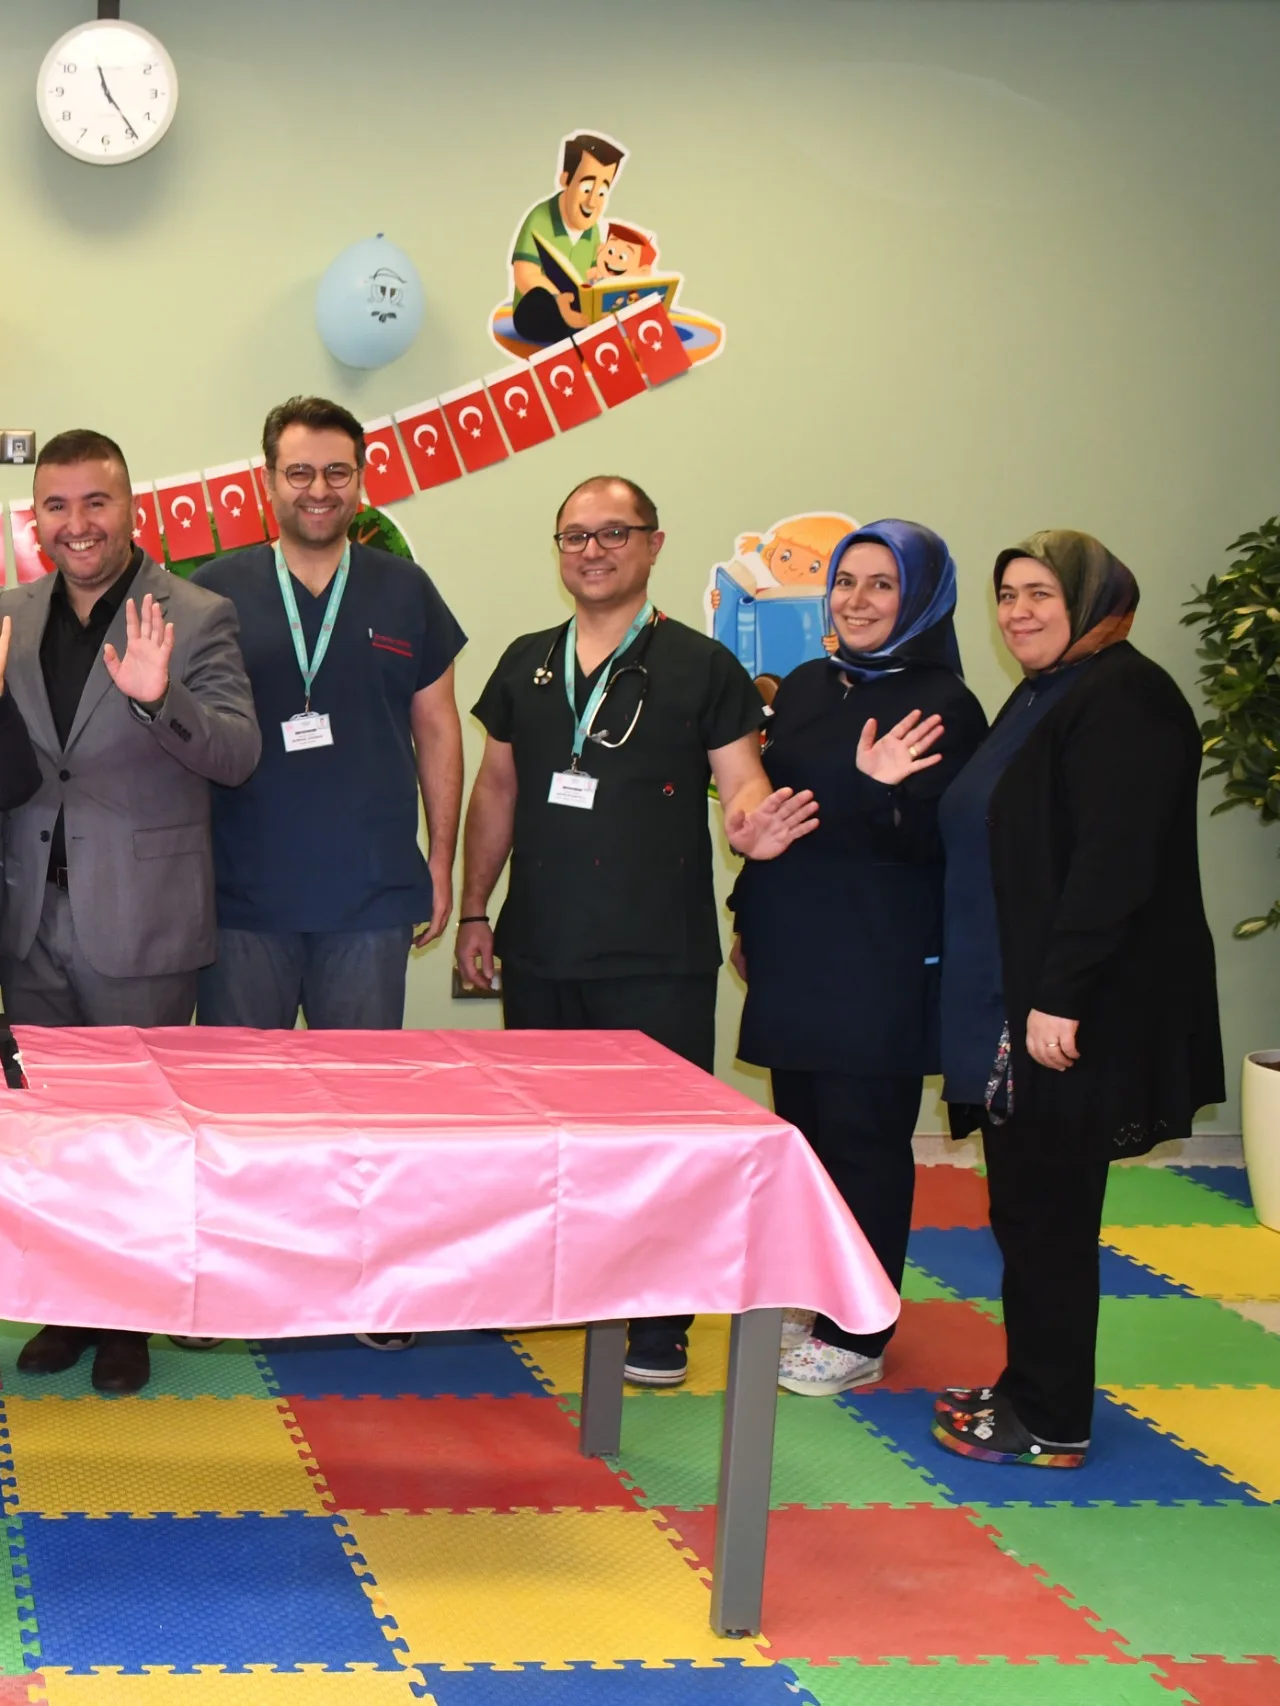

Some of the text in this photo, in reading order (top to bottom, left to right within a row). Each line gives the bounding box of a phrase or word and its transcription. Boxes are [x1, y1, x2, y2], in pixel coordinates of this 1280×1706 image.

[63, 63, 77, 74] 10
[143, 63, 152, 75] 2
[56, 86, 65, 97] 9
[149, 88, 158, 99] 3
[62, 110, 71, 121] 8
[101, 134, 111, 146] 6
